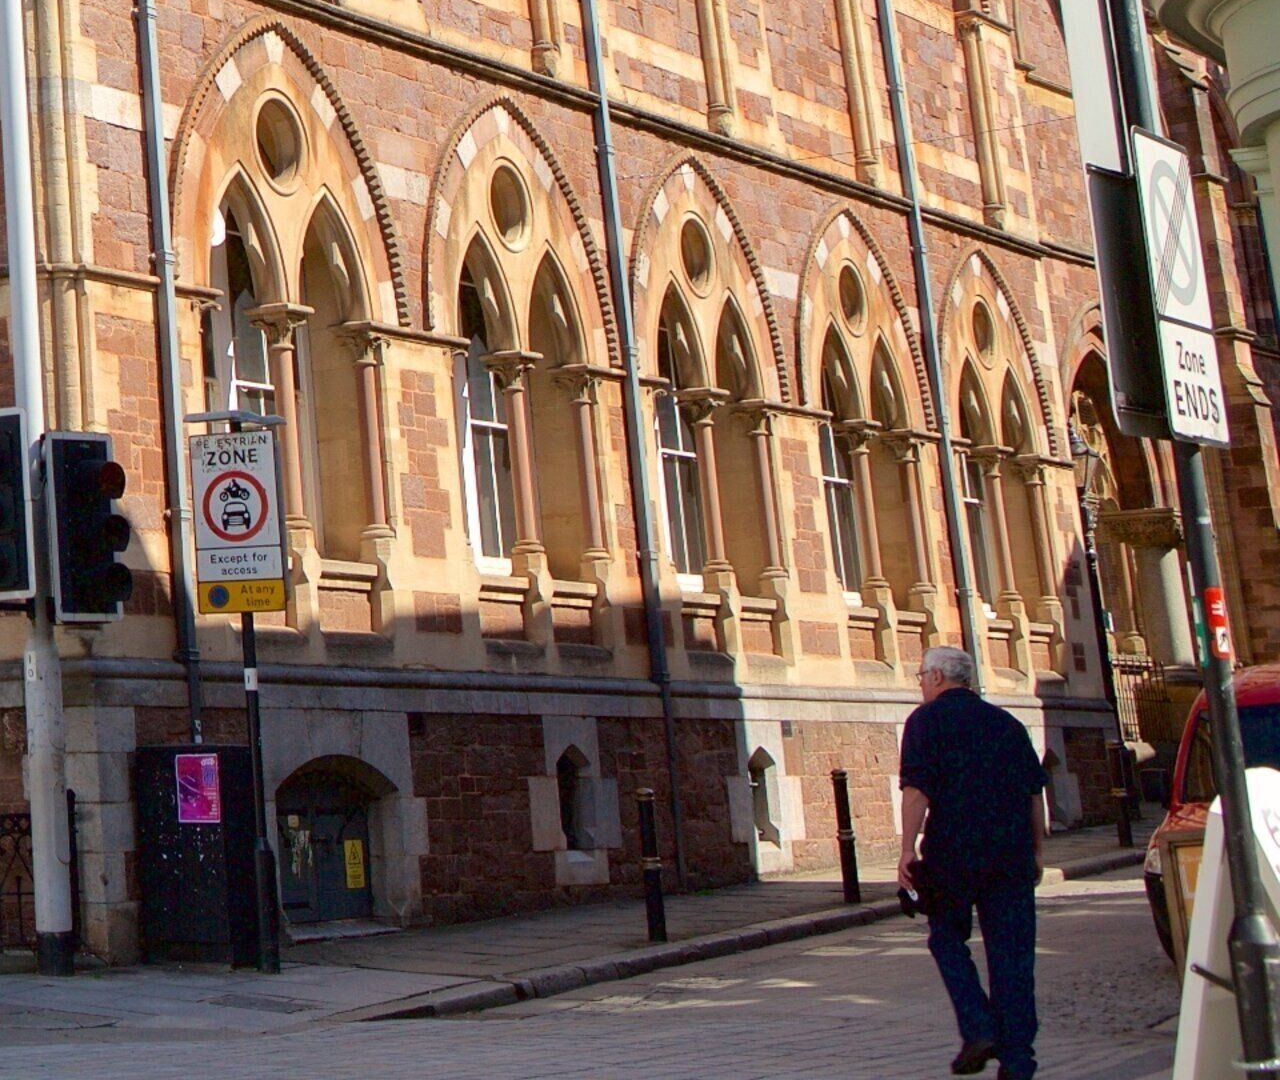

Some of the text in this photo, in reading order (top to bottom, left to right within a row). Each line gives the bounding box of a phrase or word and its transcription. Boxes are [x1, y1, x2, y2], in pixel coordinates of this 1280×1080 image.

[1175, 340, 1206, 376] Zone
[1173, 379, 1221, 425] ENDS
[196, 434, 268, 450] PEESTRIAN
[206, 448, 259, 467] ZONE
[209, 551, 268, 565] Except for
[220, 566, 259, 576] access
[240, 584, 276, 596] At any
[245, 596, 272, 607] time
